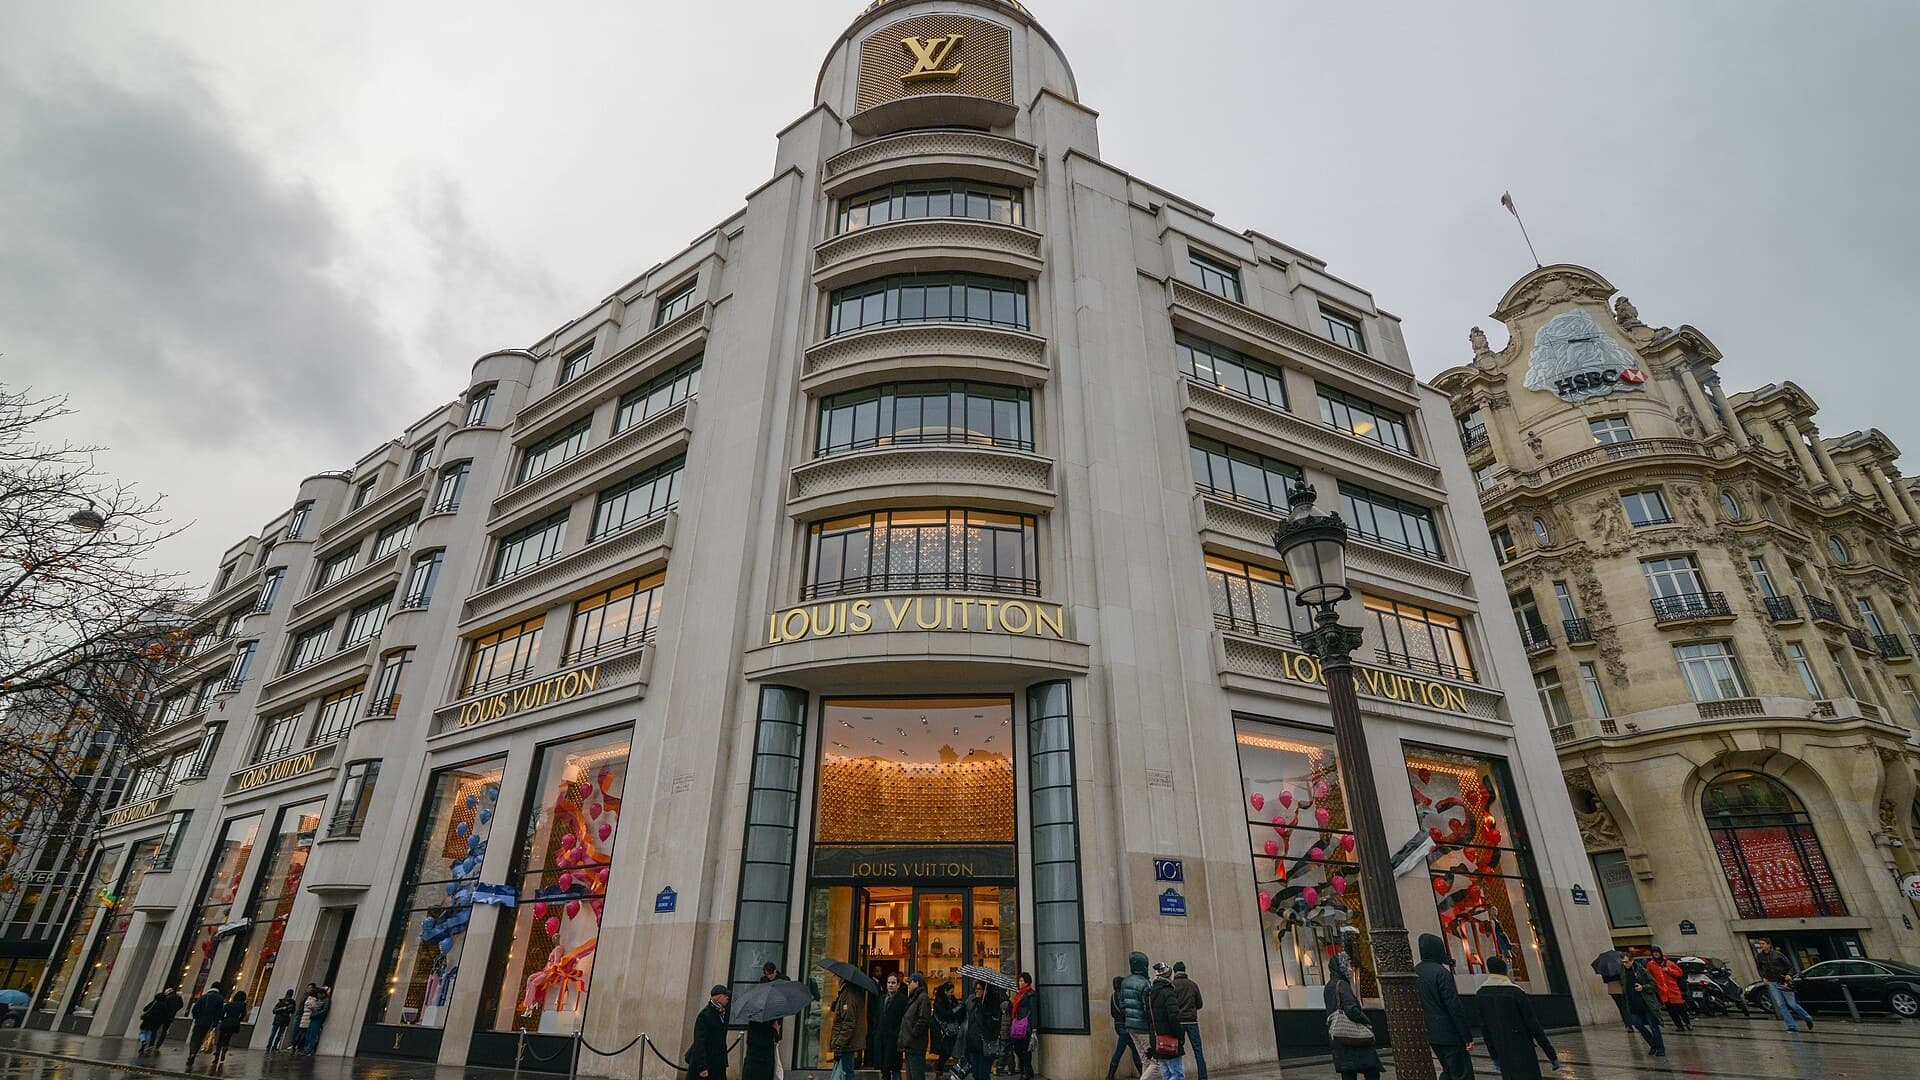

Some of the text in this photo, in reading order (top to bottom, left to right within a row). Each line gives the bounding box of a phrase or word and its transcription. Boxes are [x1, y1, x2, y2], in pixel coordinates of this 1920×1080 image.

[1554, 368, 1619, 396] HSBC
[768, 597, 1064, 644] LOUIS VUITTON
[459, 665, 599, 728] LOUIS VUITTON
[1281, 651, 1468, 713] LOU VUITTON
[239, 751, 317, 790] LOUIS VUITTON
[852, 863, 974, 877] LOUIS VUITTON
[1155, 860, 1182, 880] 101
